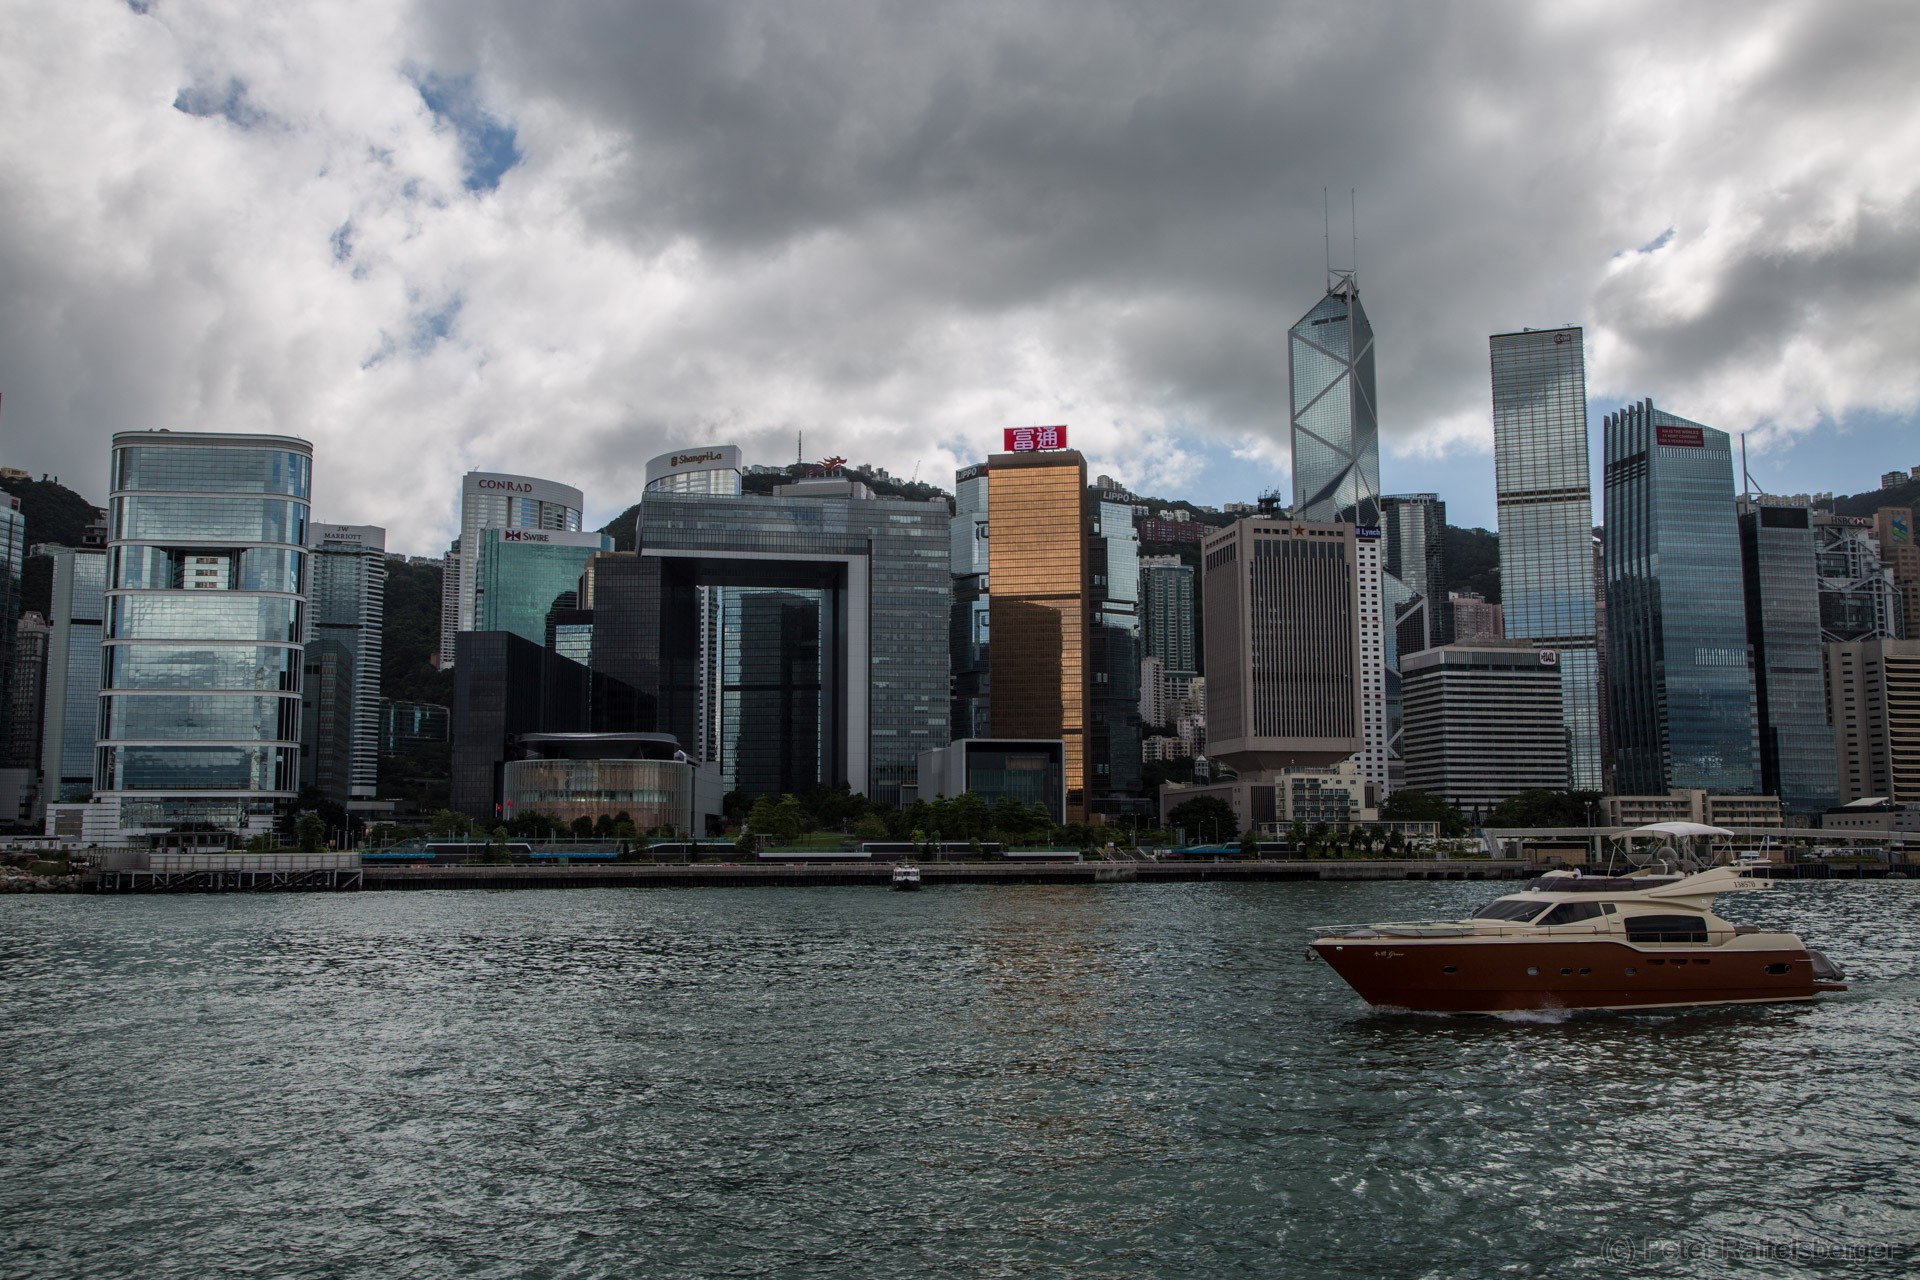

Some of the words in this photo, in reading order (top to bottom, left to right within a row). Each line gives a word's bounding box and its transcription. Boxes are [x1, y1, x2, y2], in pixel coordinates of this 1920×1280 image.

[1013, 427, 1058, 450] 富通
[679, 452, 722, 464] Shangri-La
[957, 467, 977, 480] LIPPO
[479, 479, 533, 493] CONRAD
[1103, 491, 1130, 502] LIPPO
[1831, 516, 1854, 525] HSBC
[1361, 528, 1380, 536] Lynch
